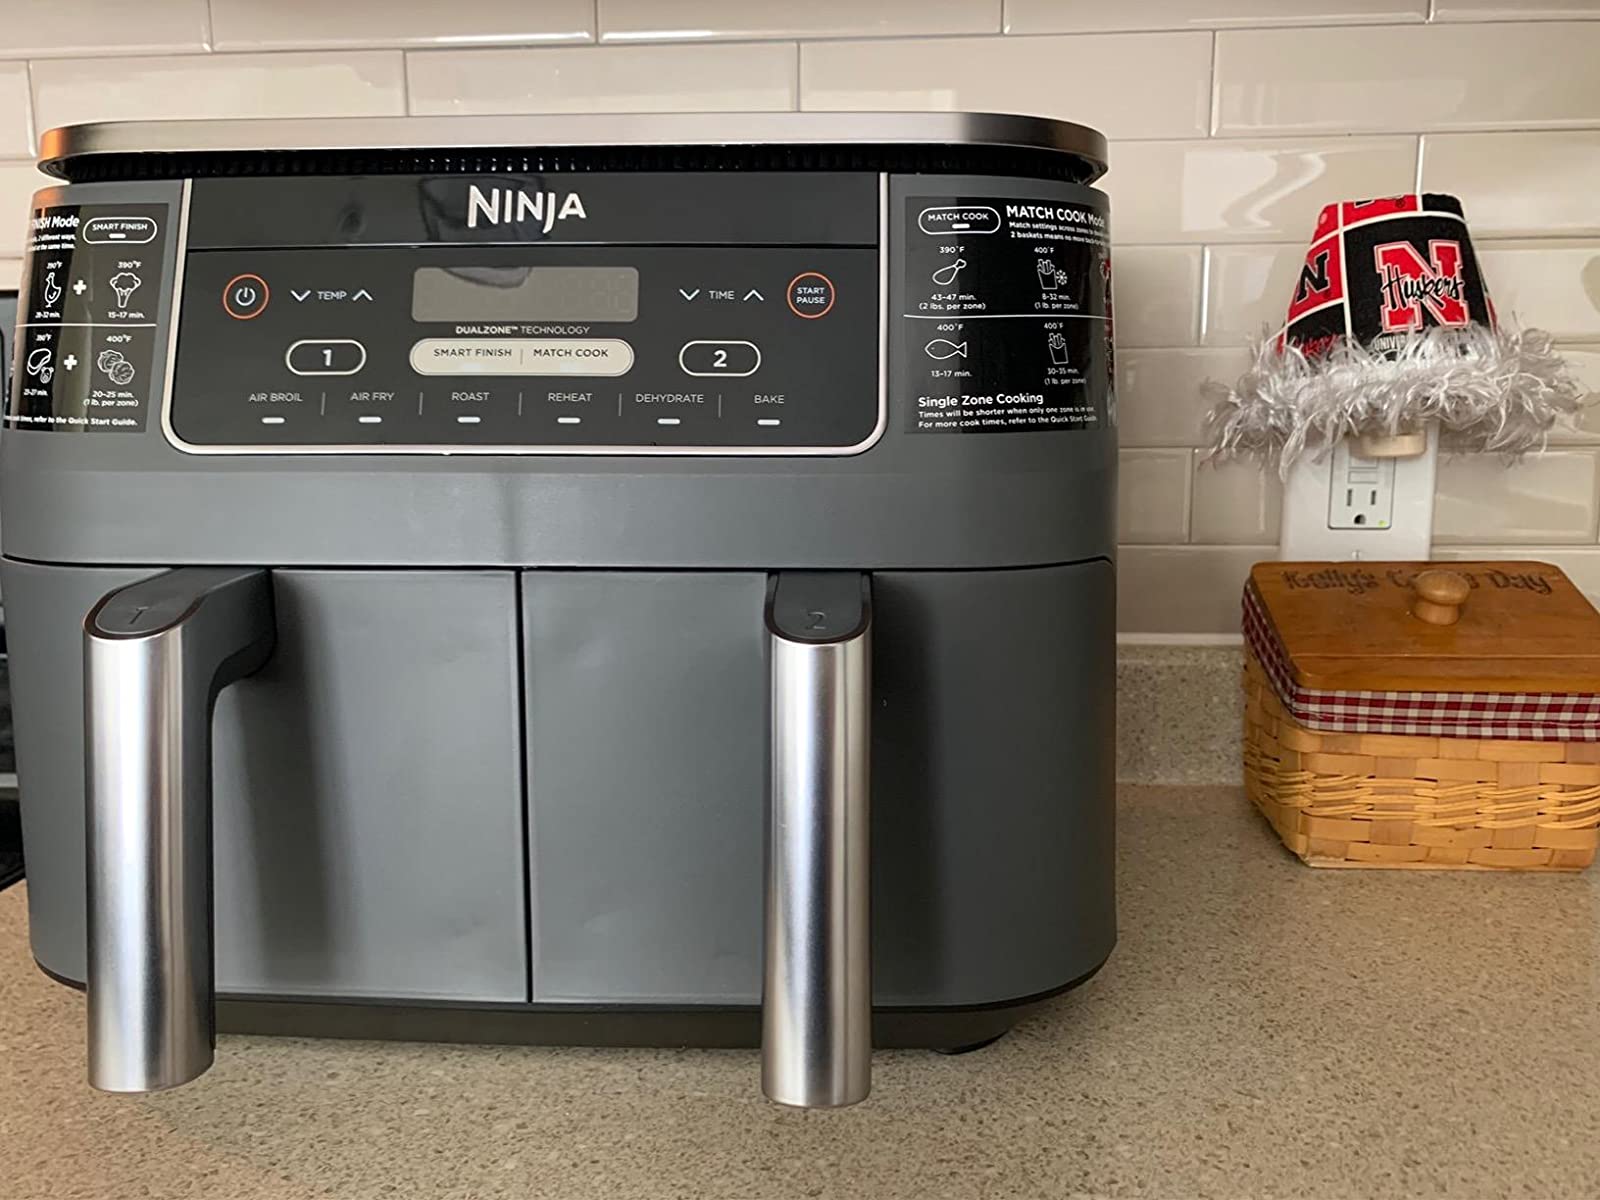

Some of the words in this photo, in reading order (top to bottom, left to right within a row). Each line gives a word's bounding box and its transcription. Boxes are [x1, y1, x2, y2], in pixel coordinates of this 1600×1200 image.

[467, 184, 588, 234] NINJA
[1005, 204, 1054, 220] MATCH
[1056, 208, 1087, 224] COOK
[51, 214, 80, 228] Mode
[928, 212, 960, 222] MATCH
[962, 212, 990, 221] COOK
[92, 222, 119, 232] SMART
[120, 222, 148, 231] FINISH
[1009, 221, 1031, 229] Match
[1032, 222, 1058, 232] settings
[1010, 230, 1015, 238] 2
[1016, 231, 1043, 239] baskets
[939, 245, 965, 254] 390°F
[1033, 246, 1054, 254] 400°F
[117, 260, 142, 269] 390°F
[1296, 249, 1331, 303] N
[1374, 239, 1469, 332] N
[1381, 263, 1465, 310] Huskers
[317, 290, 347, 301] TEMP
[709, 290, 735, 300] TIME
[796, 287, 825, 295] START
[930, 293, 957, 301] 43-47
[958, 293, 977, 301] min.
[919, 302, 929, 311] (2
[929, 302, 945, 310] lbs.
[946, 303, 961, 311] per
[962, 302, 986, 311] zone)
[107, 311, 128, 319] 15-17
[128, 311, 145, 319] min.
[520, 325, 591, 336] TECHNOLOGY
[936, 323, 965, 331] 400°F
[1043, 322, 1064, 330] 400°F
[106, 334, 132, 343] 400°F
[322, 349, 333, 367] 1
[433, 348, 471, 358] SMART
[475, 348, 513, 358] FINISH
[533, 348, 573, 358] MATCH
[575, 348, 609, 358] COOK
[712, 350, 728, 368] 2
[931, 370, 953, 378] 13-17
[954, 370, 973, 378] min.
[92, 390, 117, 398] 20-25
[117, 390, 134, 398] min.
[249, 392, 269, 403] AIR
[272, 392, 303, 403] BROIL
[350, 392, 369, 402] AIR
[372, 392, 395, 402] FRY
[451, 392, 490, 402] ROAST
[548, 392, 592, 403] REHEAT
[635, 393, 704, 404] DEHYDRATE
[83, 399, 90, 407] (1
[116, 399, 139, 407] zone)
[754, 394, 785, 405] BAKE
[918, 395, 958, 409] Single
[961, 394, 993, 406] Zone
[996, 392, 1044, 407] Cooking
[918, 410, 944, 418] Times
[945, 409, 961, 417] will
[963, 409, 974, 417] be
[975, 408, 1005, 416] shorter
[1006, 407, 1027, 415] when
[1029, 407, 1044, 415] only
[56, 416, 67, 424] the
[68, 417, 89, 425] Quick
[90, 418, 110, 426] Start
[111, 418, 138, 426] Guide.
[918, 420, 933, 428] For
[935, 420, 957, 428] more
[959, 419, 980, 427] cook
[982, 417, 1008, 426] times,
[1050, 415, 1068, 423] Quick
[1487, 567, 1554, 594] Day
[805, 610, 828, 630] 2
